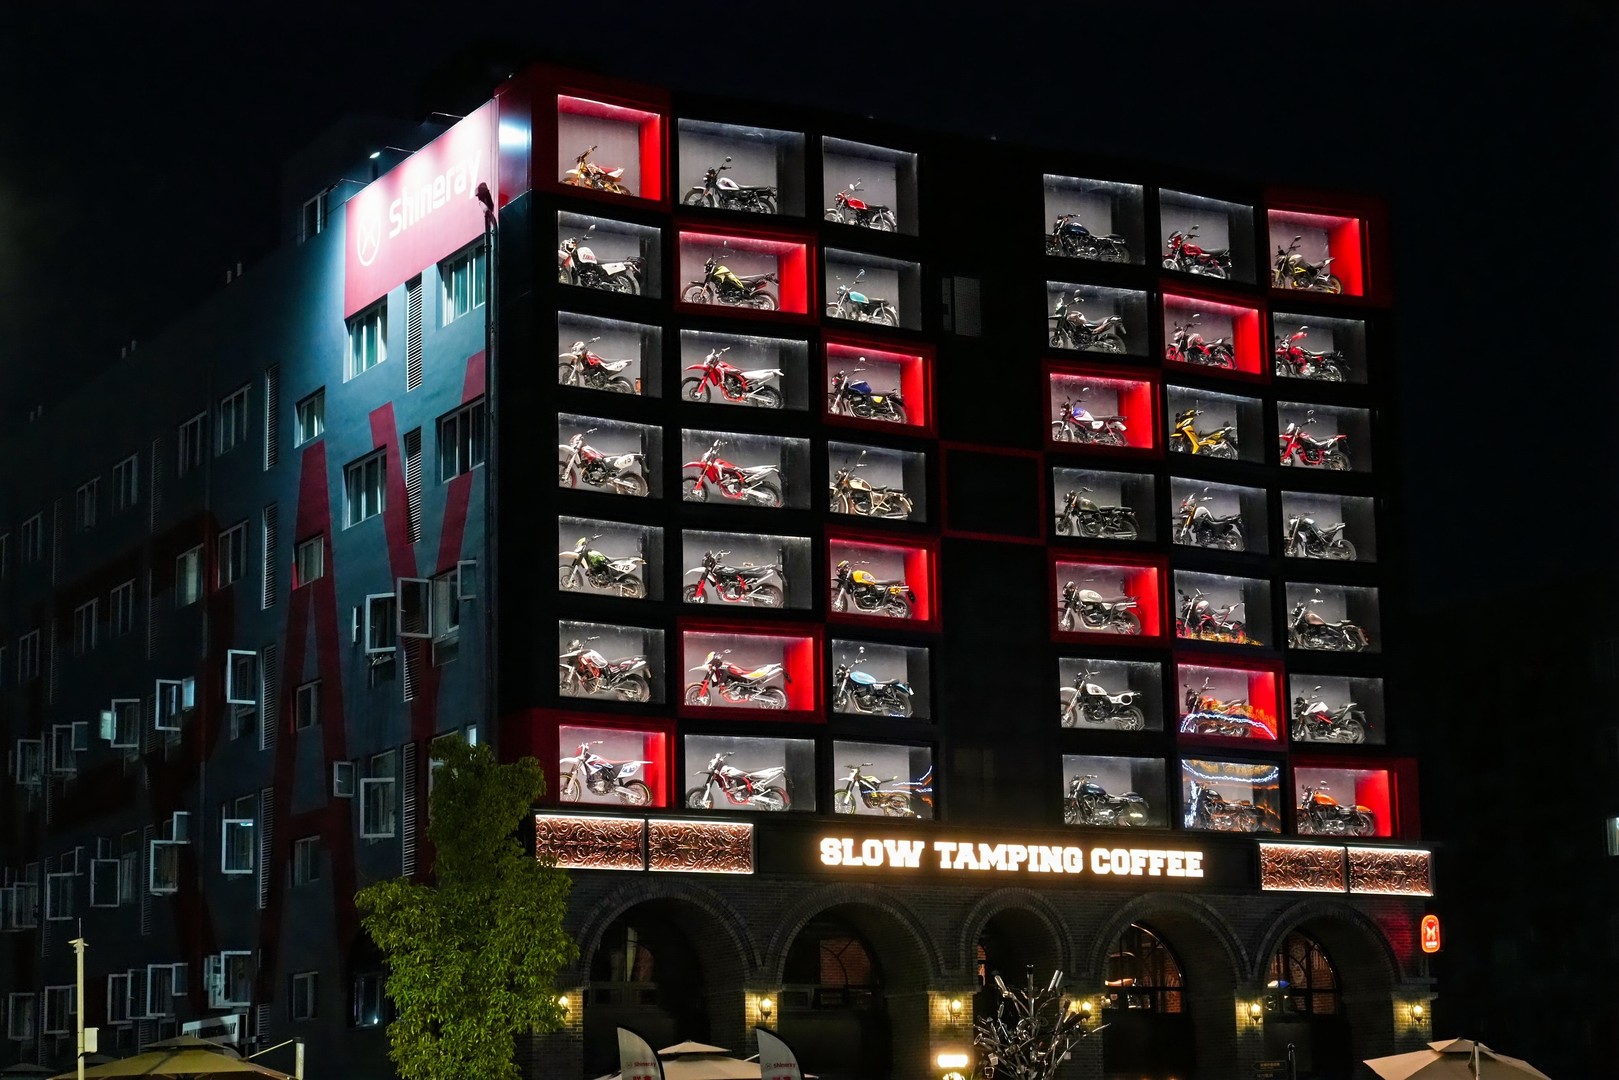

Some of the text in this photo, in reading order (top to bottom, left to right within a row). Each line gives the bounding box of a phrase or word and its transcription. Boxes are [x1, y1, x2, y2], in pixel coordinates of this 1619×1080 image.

[819, 837, 1204, 878] SLOW TAMPING COFFEE
